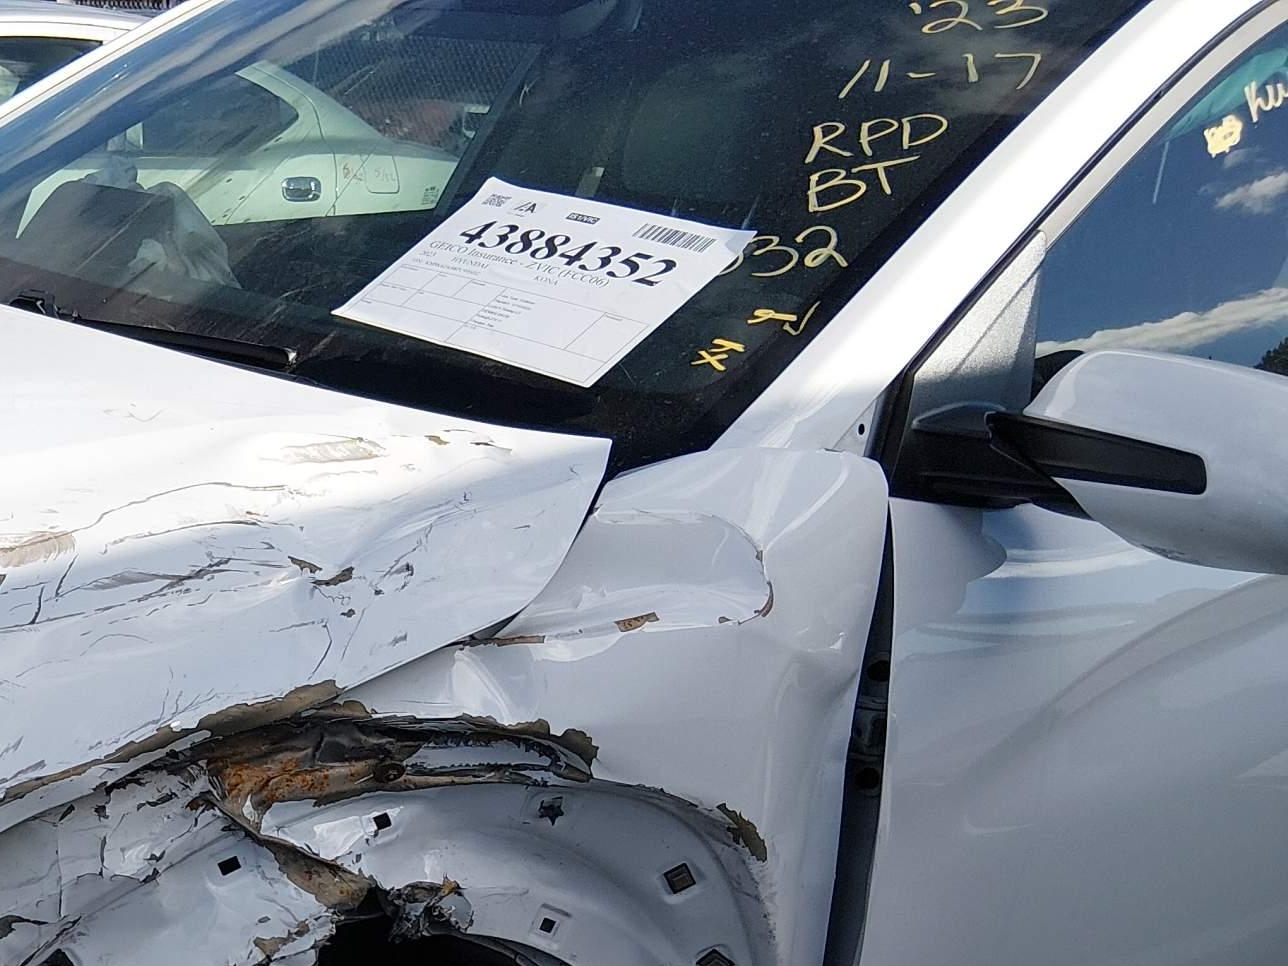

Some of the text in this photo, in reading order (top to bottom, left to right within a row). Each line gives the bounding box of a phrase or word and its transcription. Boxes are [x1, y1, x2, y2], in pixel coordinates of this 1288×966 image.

[805, 113, 948, 163] RPD
[808, 155, 920, 212] BT
[429, 240, 468, 255] GEICO
[467, 248, 519, 265] Insurance
[525, 261, 561, 277] ZVIC
[450, 256, 490, 270] HYUNDAI
[459, 220, 678, 287] 43884352
[719, 225, 848, 277] 32
